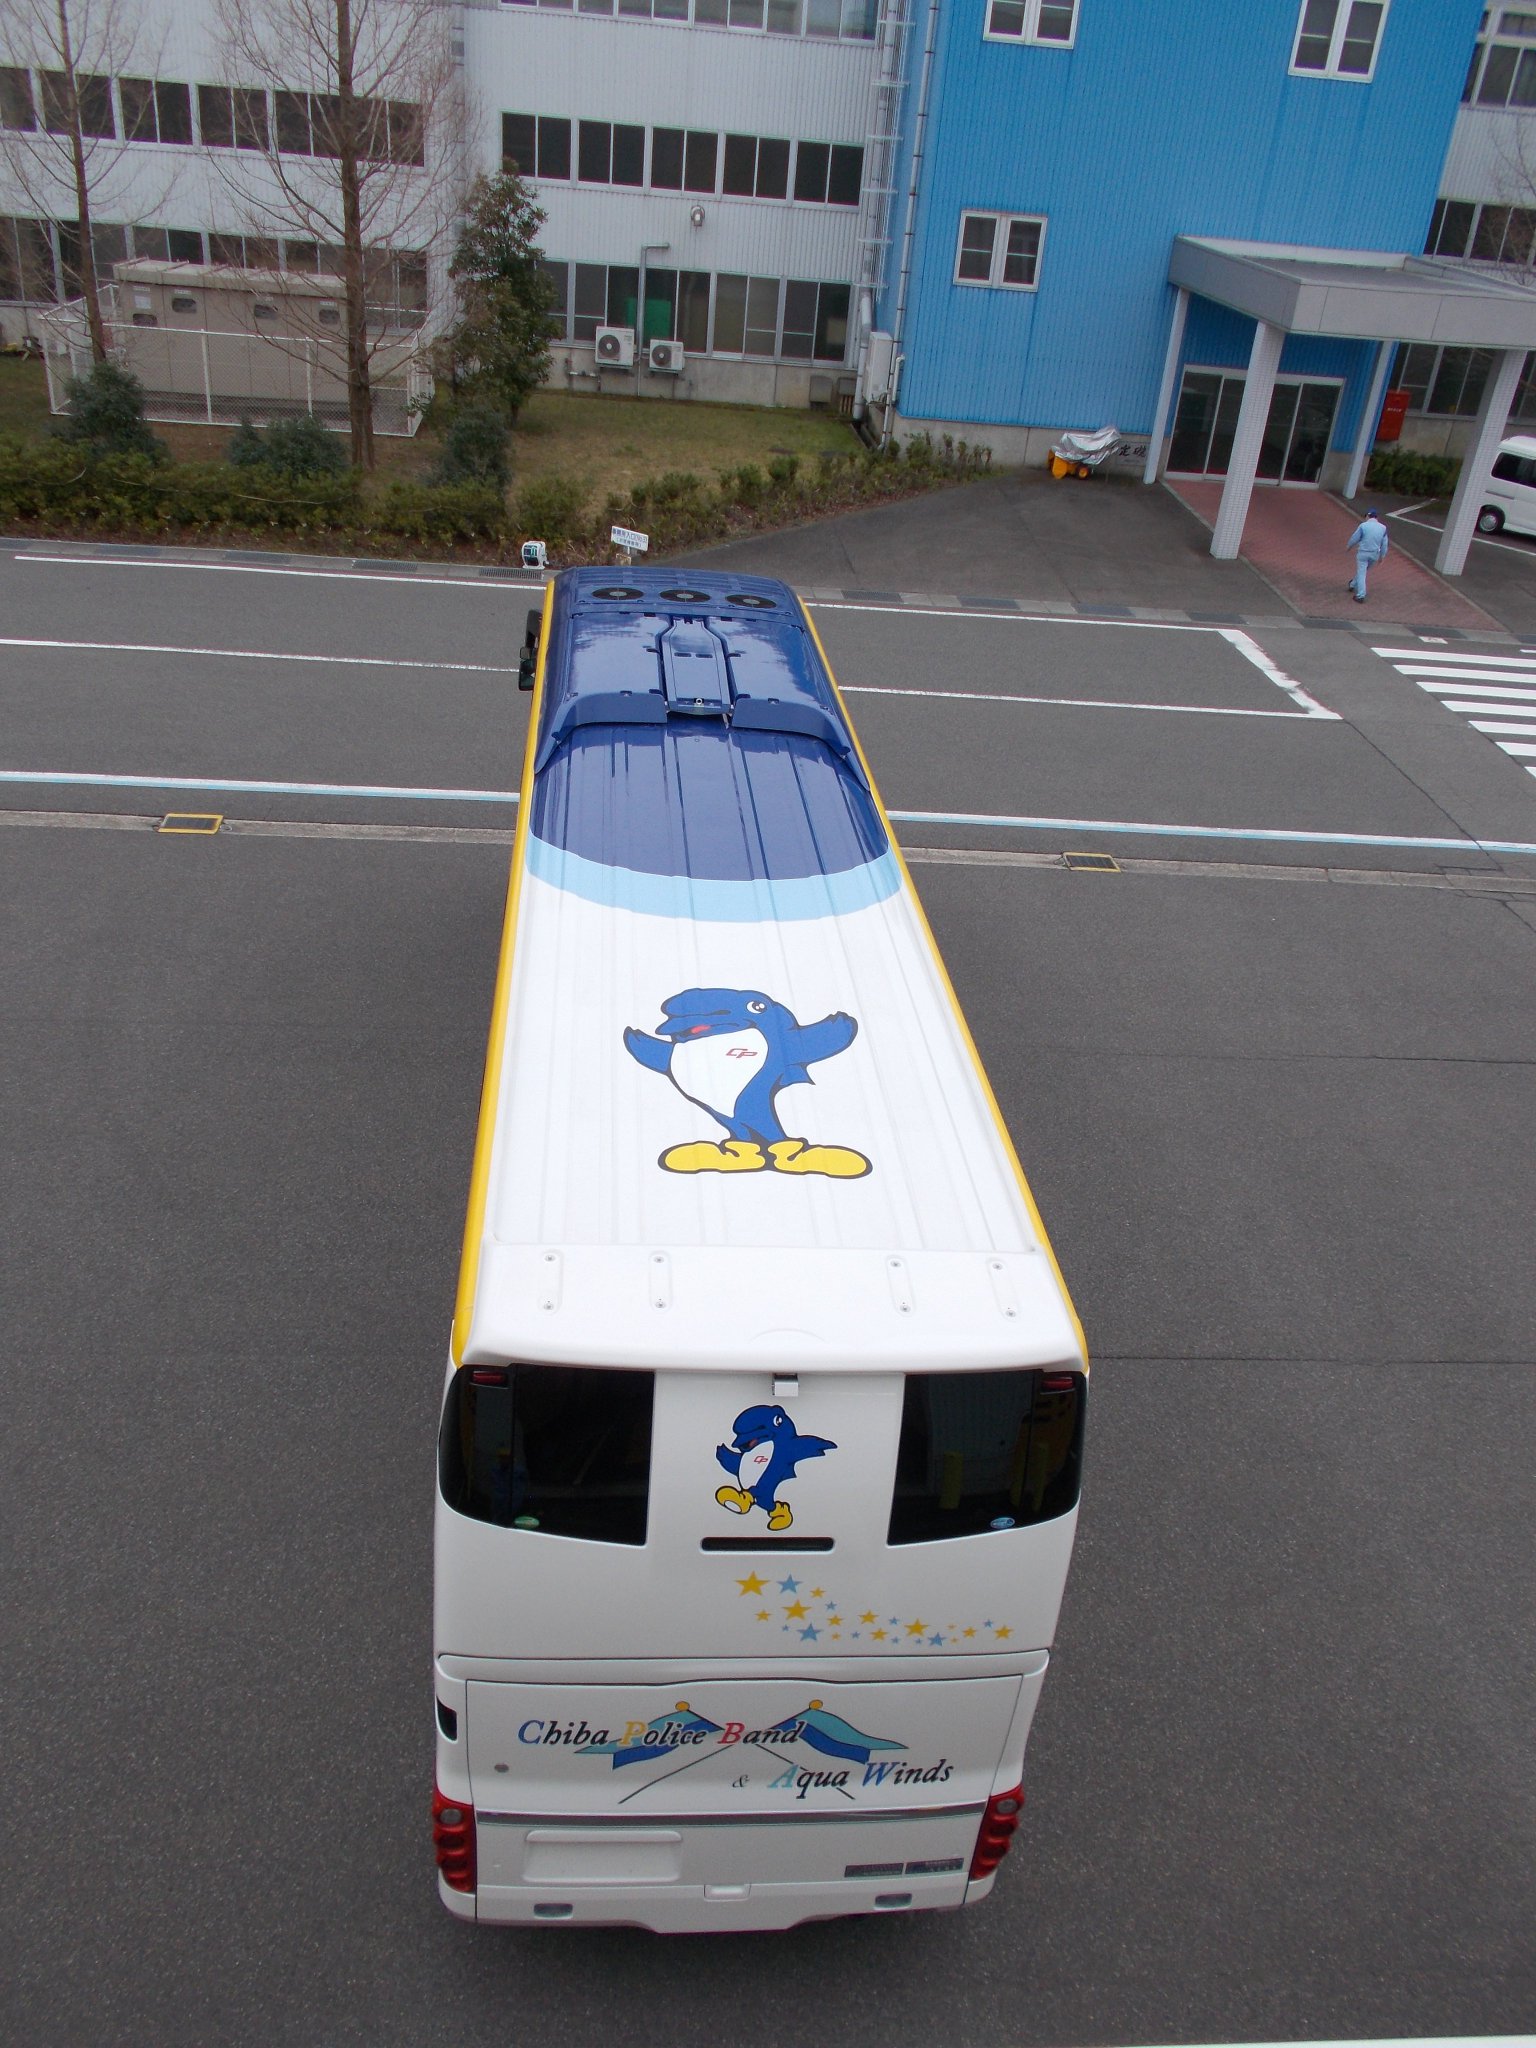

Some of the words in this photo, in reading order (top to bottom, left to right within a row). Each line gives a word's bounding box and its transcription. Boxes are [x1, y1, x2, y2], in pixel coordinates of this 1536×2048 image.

[518, 1719, 609, 1745] Chiba
[619, 1721, 707, 1746] Police
[717, 1720, 806, 1744] Band
[732, 1774, 749, 1788] &
[767, 1764, 850, 1799] Aqua
[862, 1758, 954, 1787] Winds
